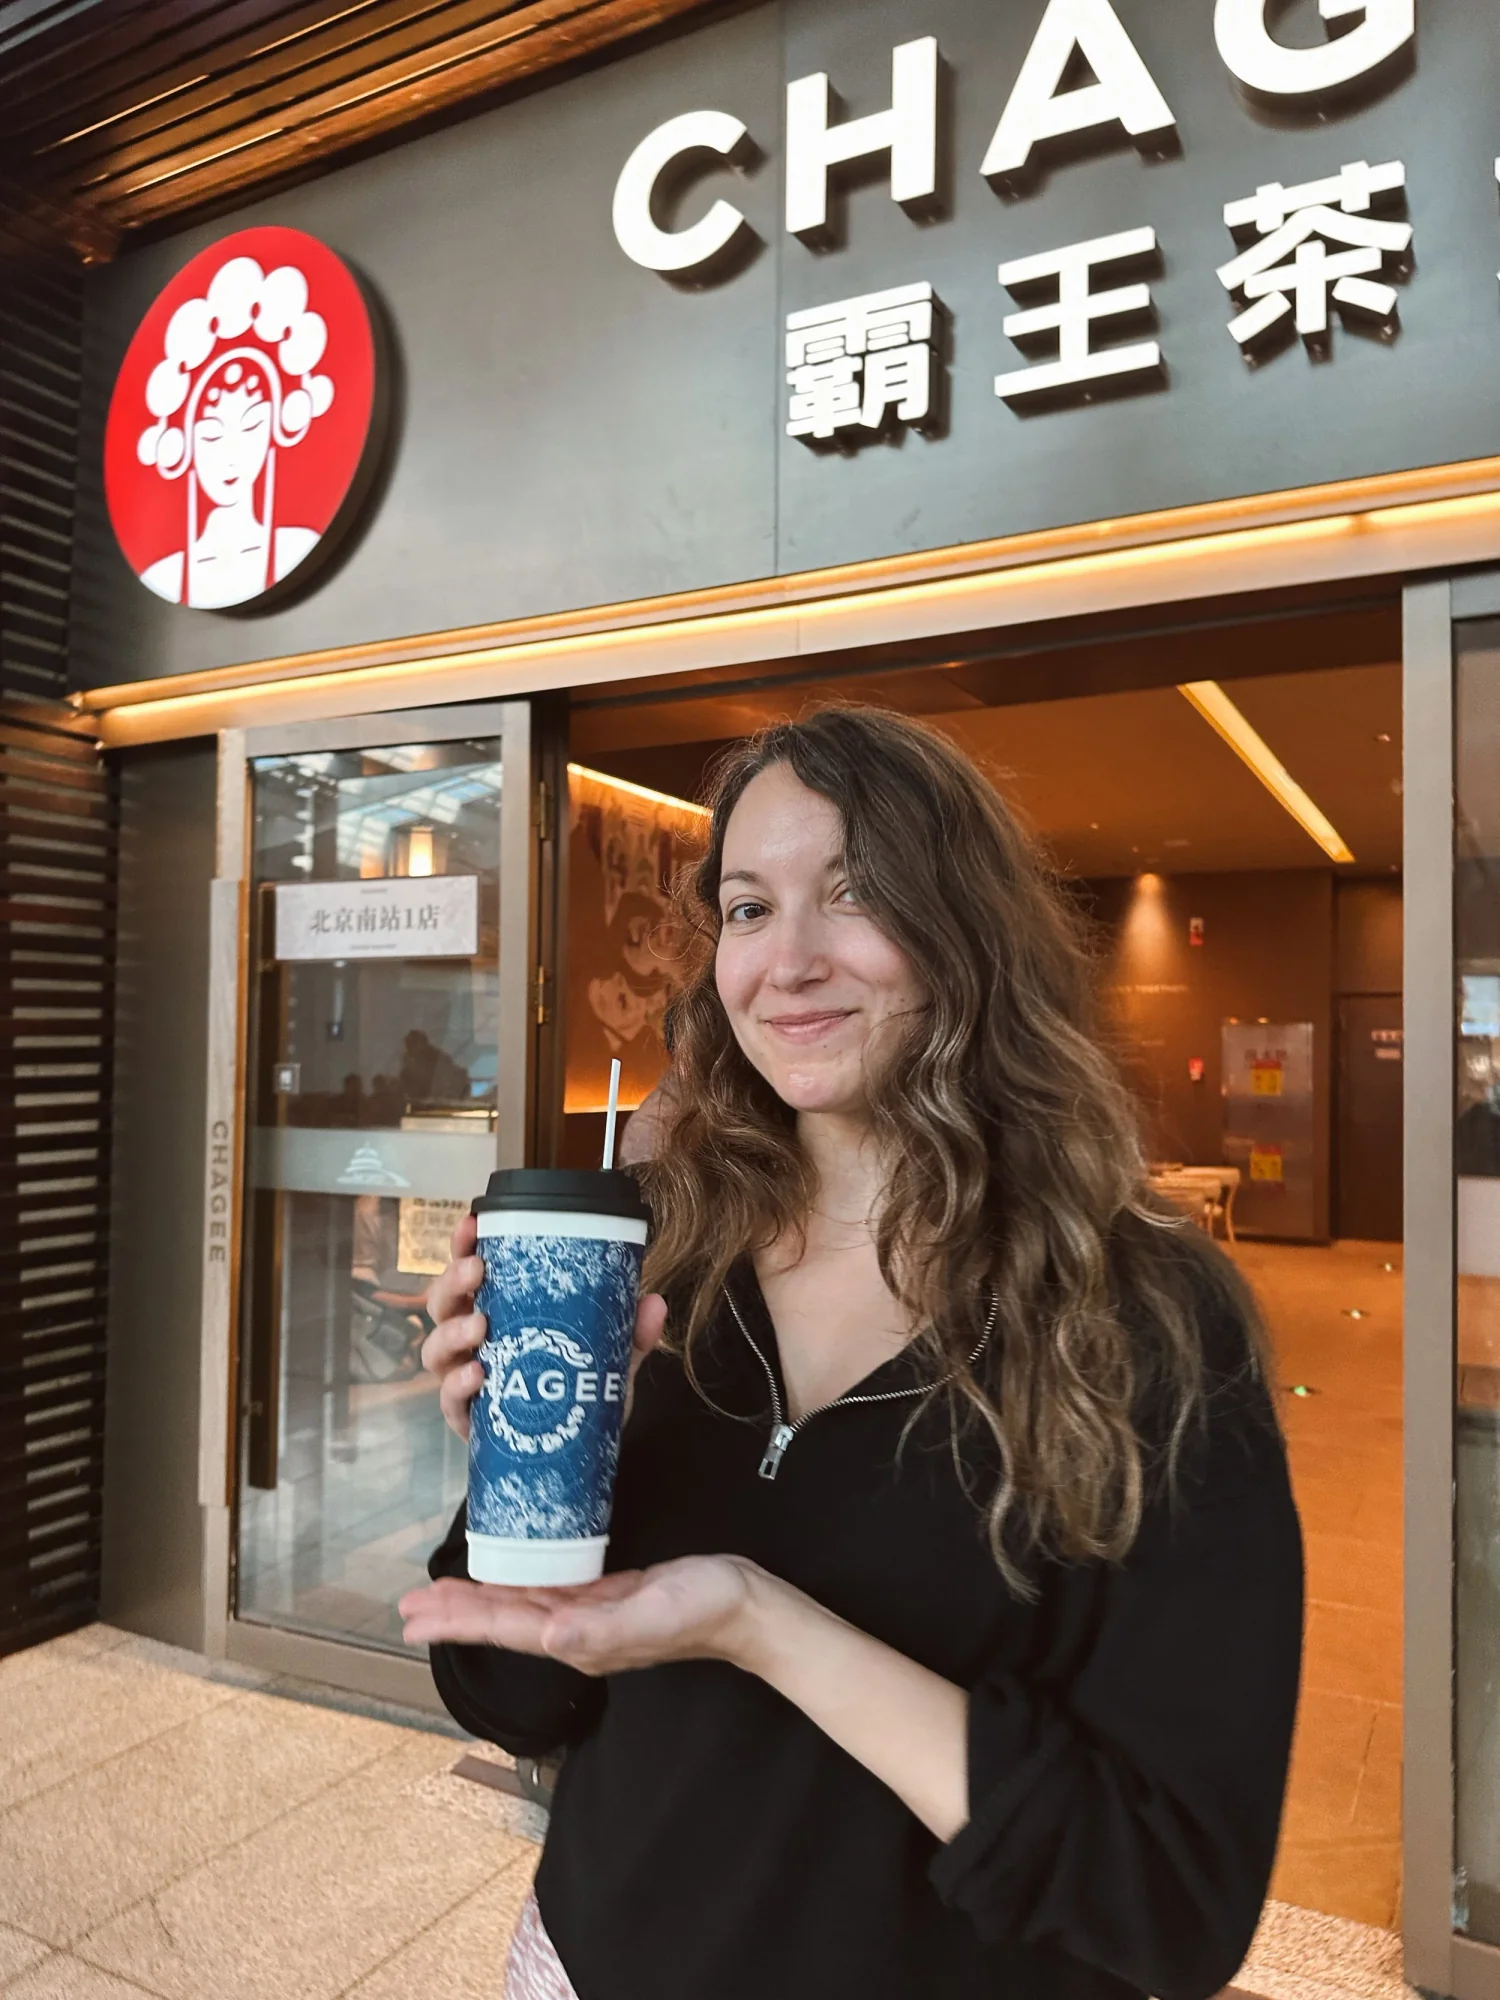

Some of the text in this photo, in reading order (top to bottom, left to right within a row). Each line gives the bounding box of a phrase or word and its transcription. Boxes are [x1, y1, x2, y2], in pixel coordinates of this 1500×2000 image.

[785, 157, 1500, 439] 霸王茶
[310, 904, 441, 934] 北京南站1店
[208, 1120, 229, 1263] CHAGEE
